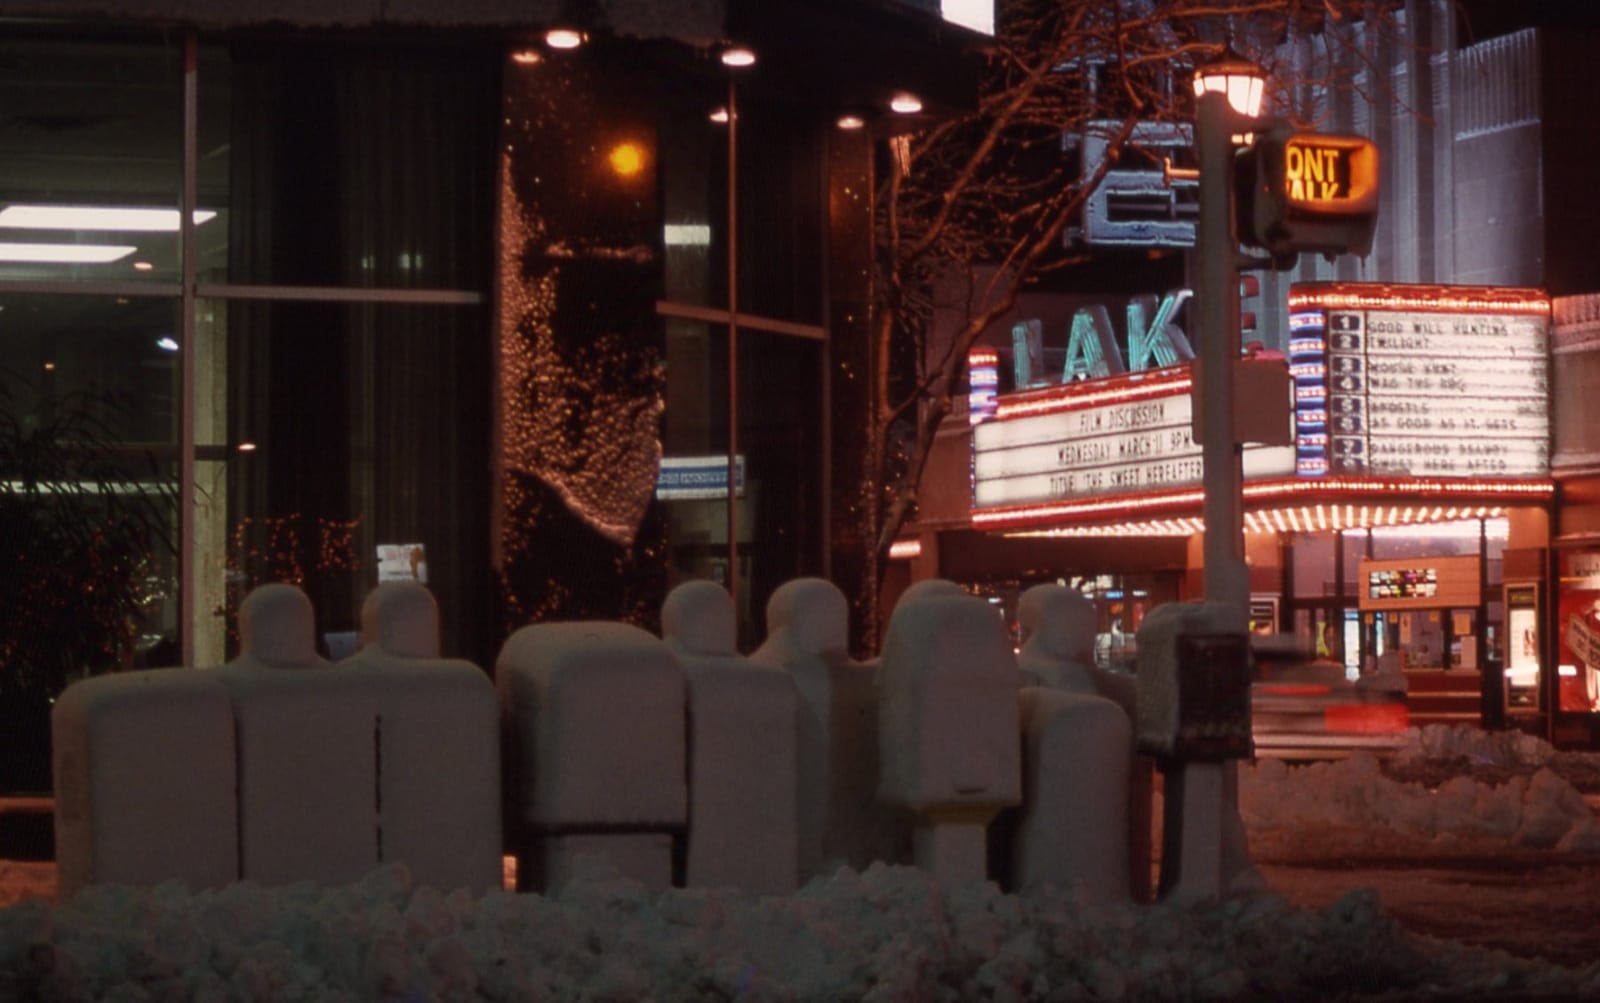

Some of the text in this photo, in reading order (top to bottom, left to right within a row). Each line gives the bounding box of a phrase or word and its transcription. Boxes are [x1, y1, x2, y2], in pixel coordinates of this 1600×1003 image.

[1286, 180, 1339, 200] ALK
[1012, 276, 1258, 390] LAK
[1341, 316, 1508, 336] 1 GOOD WILL HUNTING
[1341, 335, 1430, 349] 2 TWILIGHT
[1370, 378, 1399, 389] WAG
[1407, 378, 1430, 389] THE
[1080, 401, 1165, 433] FILM DISCUSSION
[1371, 417, 1389, 429] AS
[1397, 417, 1432, 430] GOOD
[1440, 417, 1456, 430] AS
[1057, 440, 1111, 465] WEDNESDAY
[1119, 435, 1151, 458] MARCH
[1371, 443, 1450, 456] DANGEROUS
[1110, 467, 1141, 488] SWEET
[1147, 460, 1202, 484] HEREAFTER
